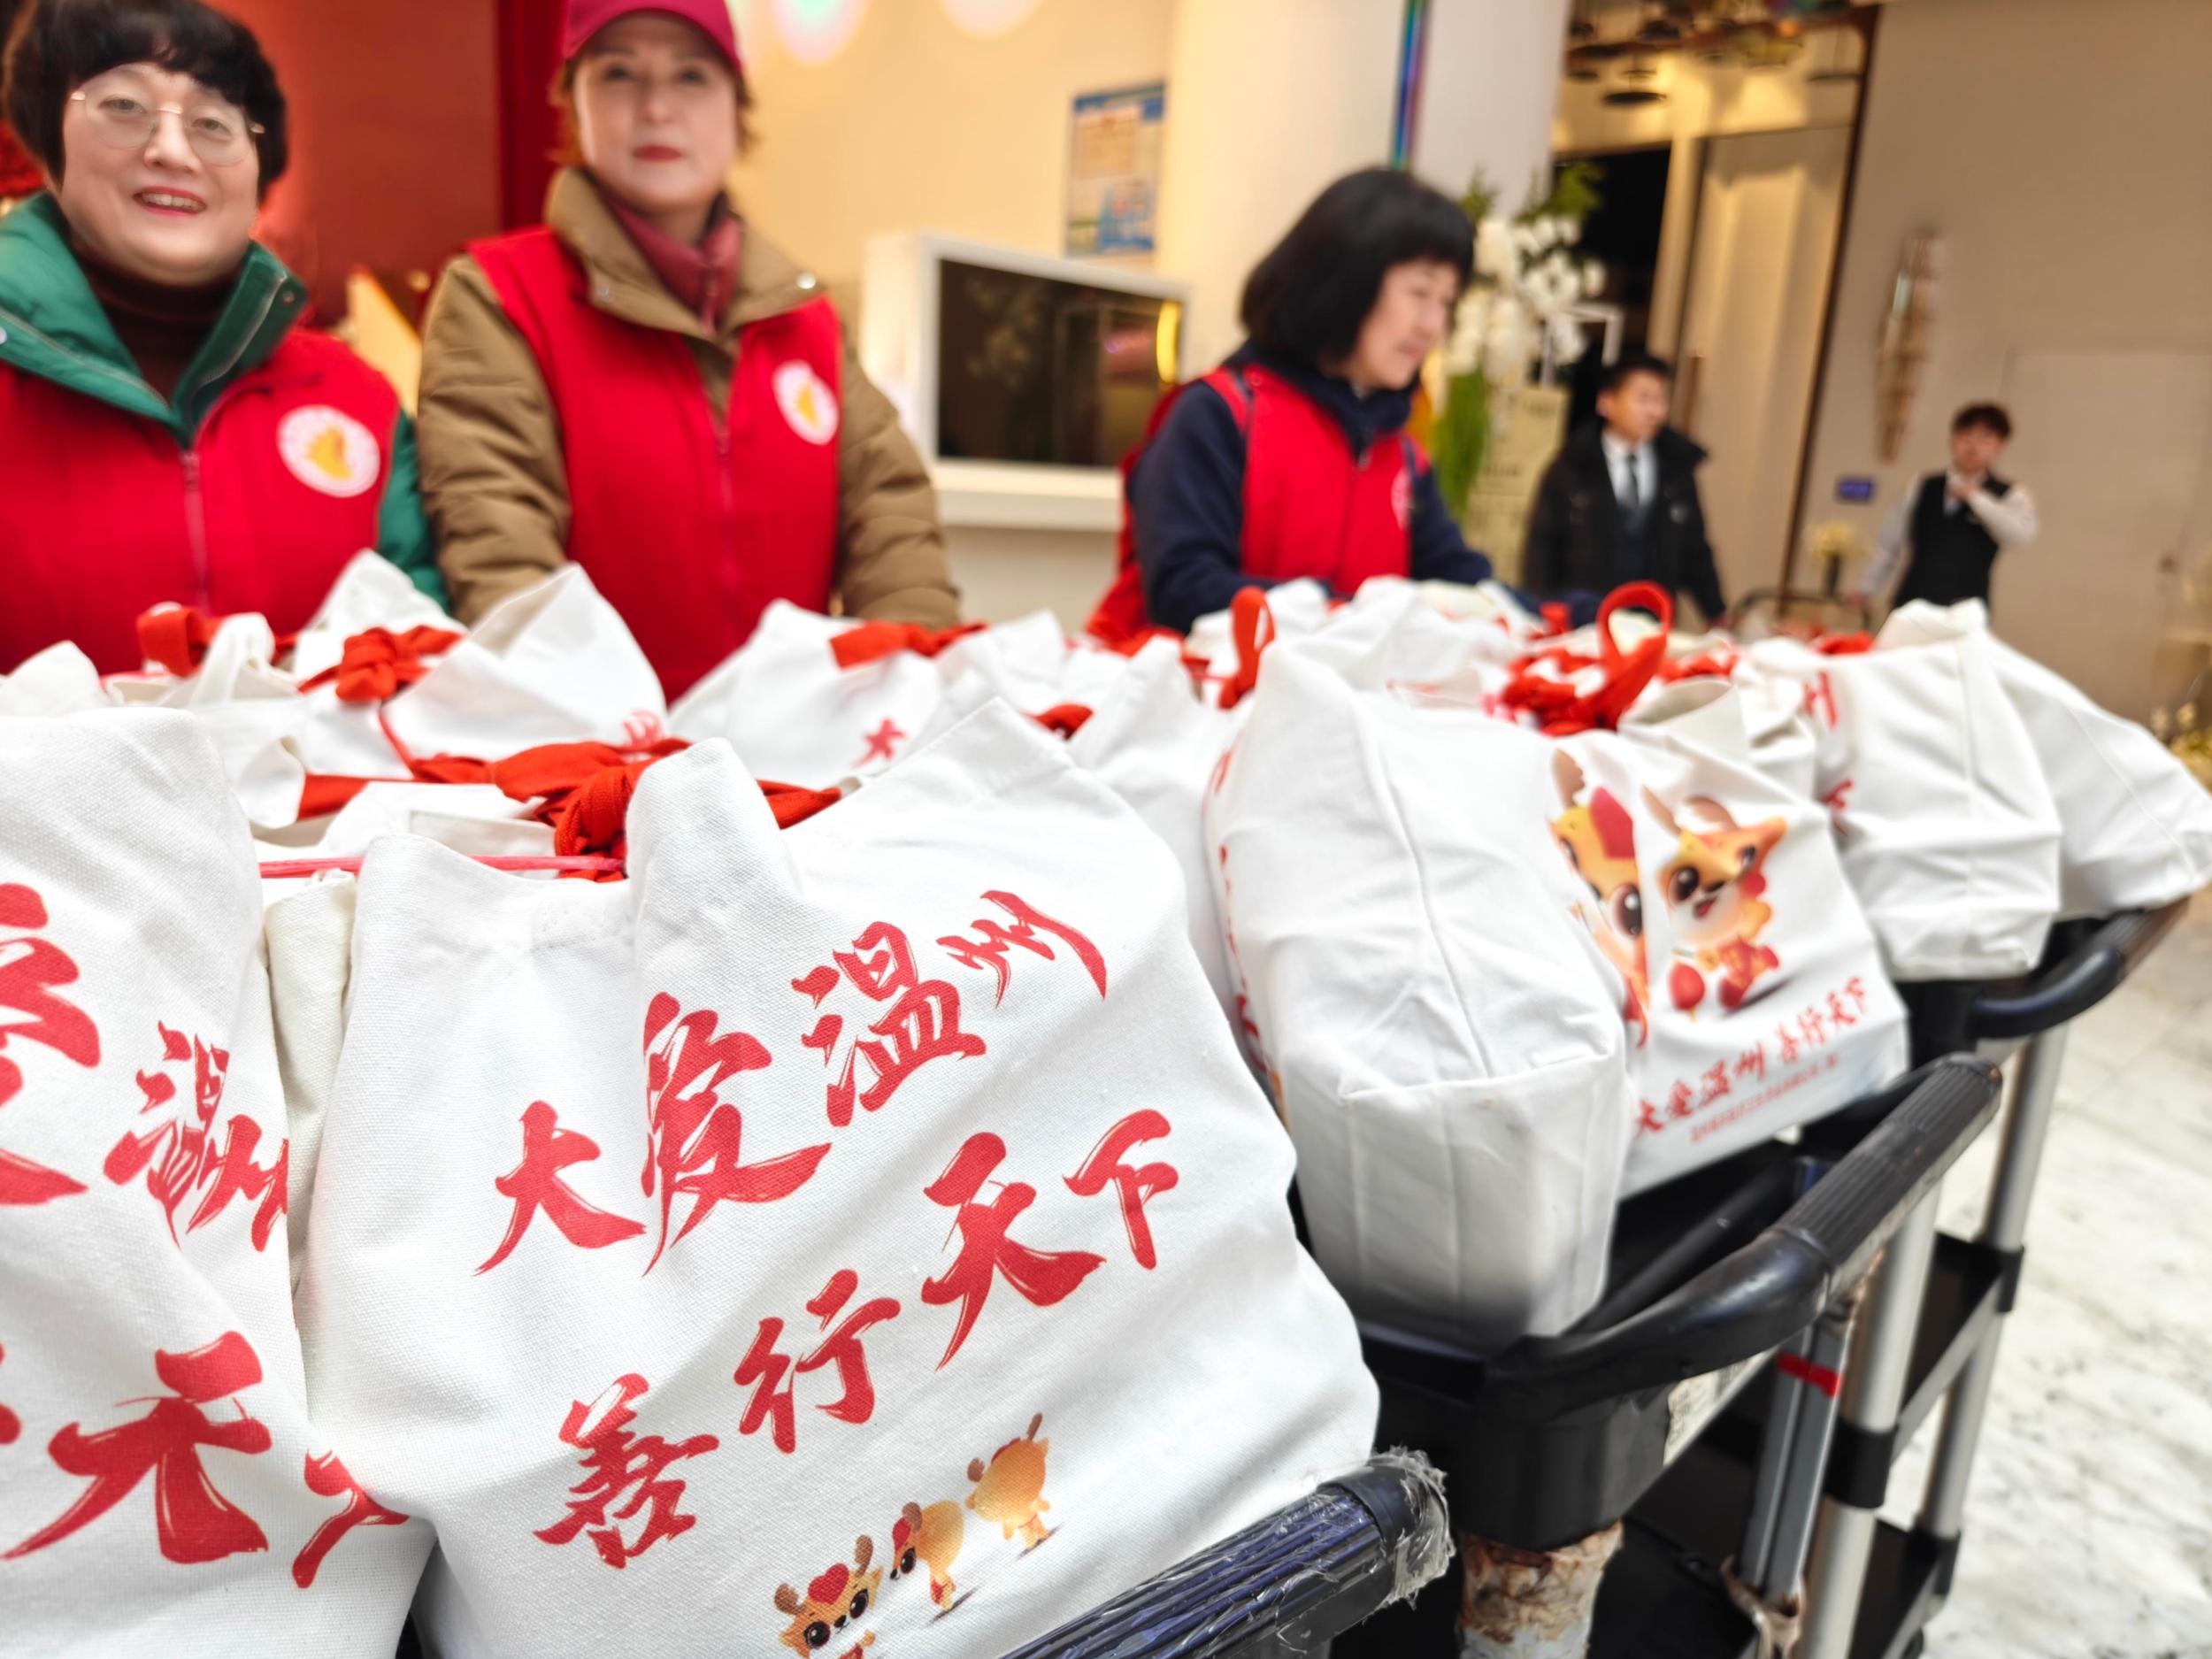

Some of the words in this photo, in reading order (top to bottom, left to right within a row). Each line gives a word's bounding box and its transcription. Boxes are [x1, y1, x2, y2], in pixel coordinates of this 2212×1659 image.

[474, 889, 1108, 1277] 大爱温州
[533, 1108, 1179, 1571] 善行天下
